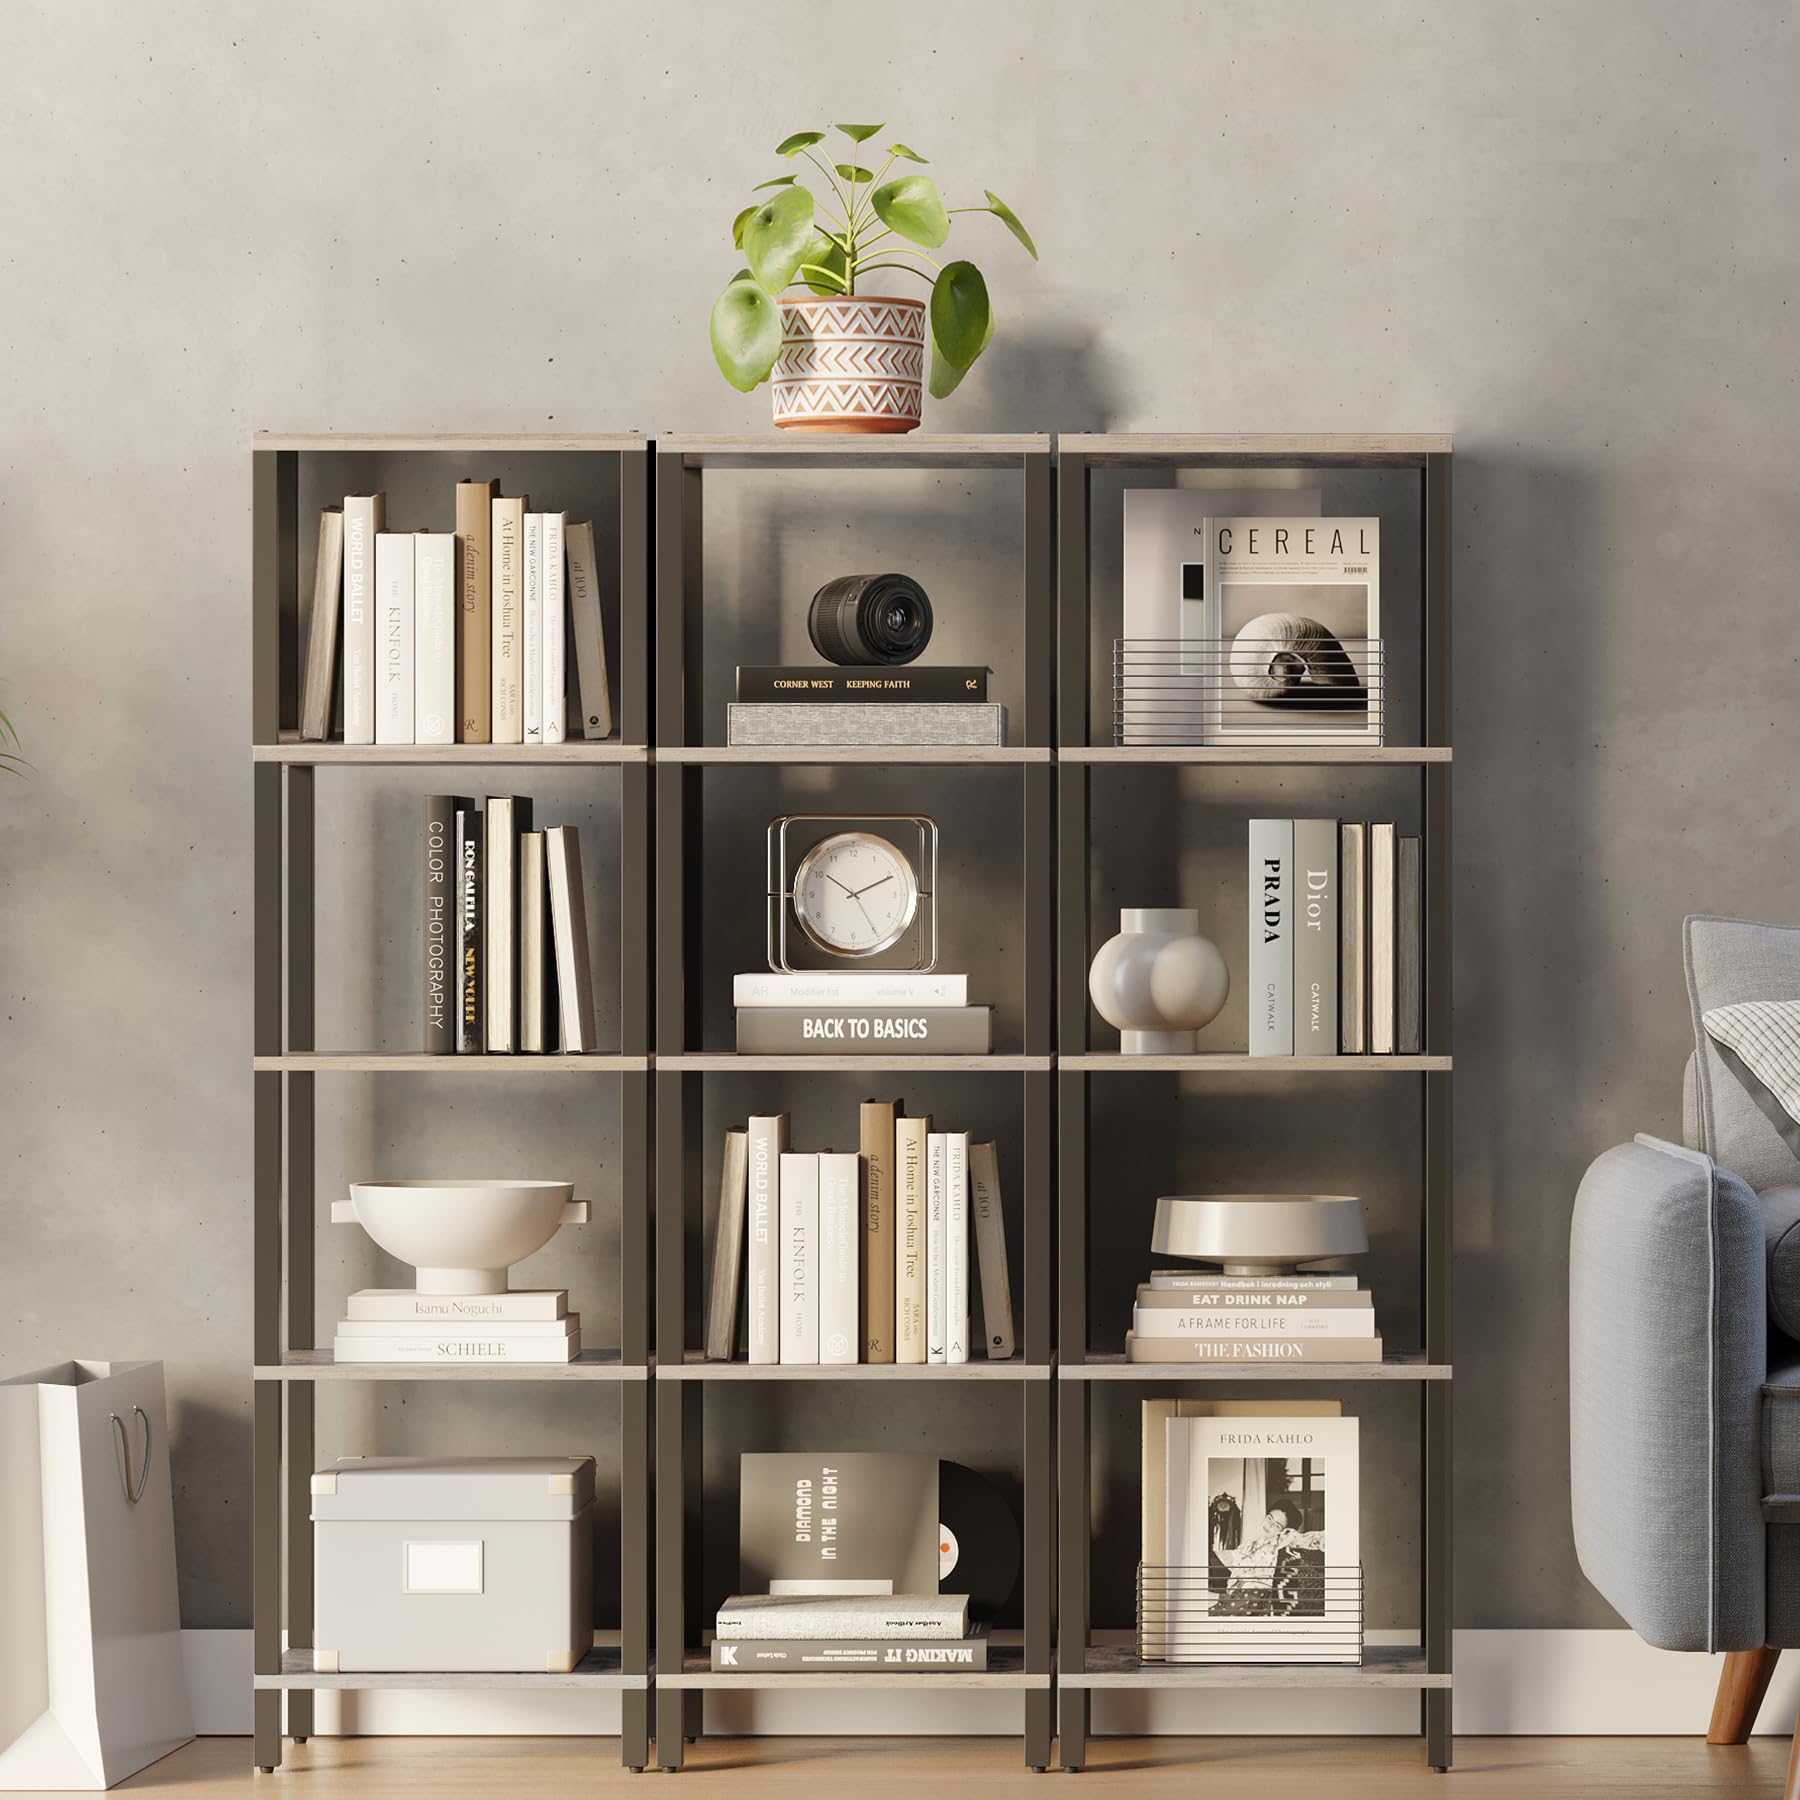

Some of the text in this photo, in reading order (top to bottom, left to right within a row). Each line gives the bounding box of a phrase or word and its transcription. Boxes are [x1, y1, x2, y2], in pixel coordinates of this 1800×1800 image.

[1219, 528, 1370, 554] CEREAL
[351, 518, 363, 624] WORLD BALLET
[466, 545, 479, 580] denim
[548, 527, 558, 601] FRIDA KAHLO
[502, 517, 514, 658] At Home in Joshua Tree
[572, 562, 587, 598] at 100
[462, 584, 478, 613] story
[389, 607, 400, 682] KINFOLK
[774, 680, 910, 689] CORNER WEST KEEPING FAITH
[548, 722, 558, 732] A
[829, 856, 838, 864] 11
[849, 849, 858, 858] 12
[465, 840, 475, 931] RON GALELLA
[815, 870, 824, 879] 10
[429, 821, 444, 1029] COLOR PHOTOGRAPHY
[816, 912, 821, 920] 8
[1264, 859, 1280, 1032] PRADA CATWALK
[1307, 869, 1328, 1032] Dior CATWALK
[465, 948, 475, 977] NEW
[803, 1018, 928, 1039] BACK TO BASICS
[756, 1137, 768, 1244] WORLD BALLET
[870, 1165, 884, 1199] denim
[952, 1147, 961, 1221] FRIDA KAHLO
[905, 1137, 917, 1278] At Home in Joshua Tree
[977, 1182, 990, 1218] at 100
[866, 1203, 881, 1233] story
[793, 1227, 805, 1303] KINFOLK
[1221, 1280, 1255, 1288] Handbok
[1261, 1280, 1298, 1289] inredning
[1299, 1280, 1313, 1288] och
[416, 1302, 503, 1317] Isamu Noguchi
[1192, 1295, 1307, 1305] EAT DRINK NAP
[1178, 1318, 1286, 1329] A FRAME FOR LIFE
[437, 1343, 506, 1356] SCHIELE
[931, 1347, 942, 1355] K
[952, 1341, 962, 1352] A
[1195, 1344, 1303, 1357] THE FASHION
[1220, 1434, 1313, 1444] FRIDA KAHLO
[822, 1467, 838, 1509] NIGHT
[796, 1479, 812, 1542] DIAMOND
[822, 1518, 837, 1541] THE
[721, 1646, 738, 1665] K
[885, 1649, 972, 1662] MAKING IT
